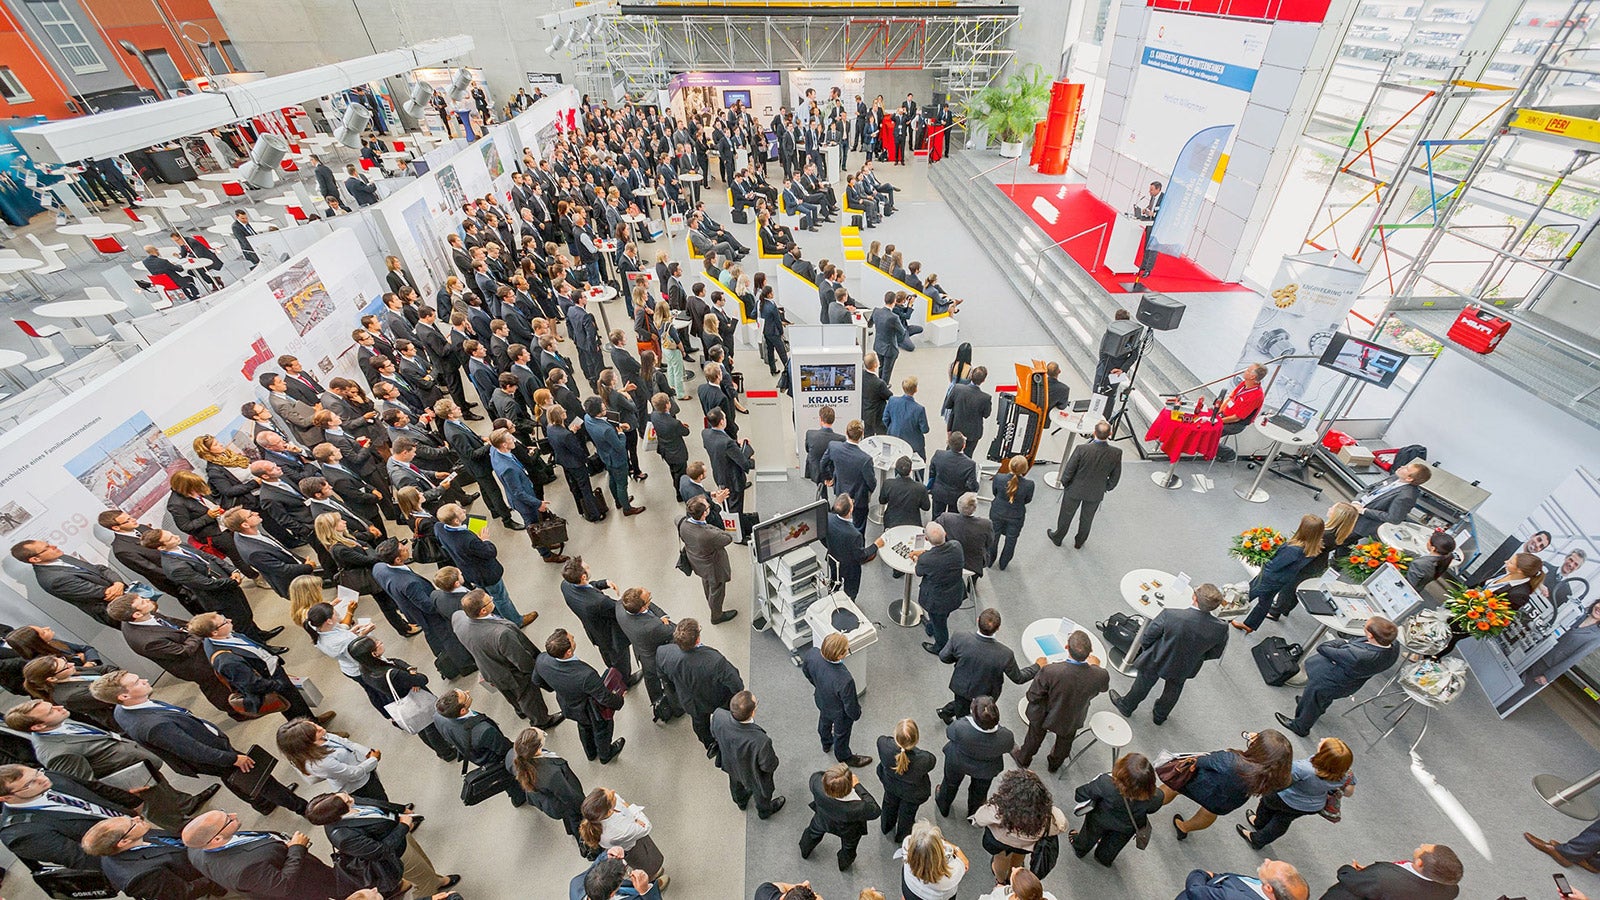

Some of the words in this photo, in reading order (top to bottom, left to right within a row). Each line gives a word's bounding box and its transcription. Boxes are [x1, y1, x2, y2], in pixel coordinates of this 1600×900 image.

[1550, 118, 1571, 130] PERI
[1461, 317, 1493, 335] HILTI
[808, 396, 849, 404] KRAUSE
[30, 452, 46, 466] eines
[45, 415, 102, 456] Familienunternehmens
[47, 512, 89, 545] 969
[724, 519, 736, 528] RI
